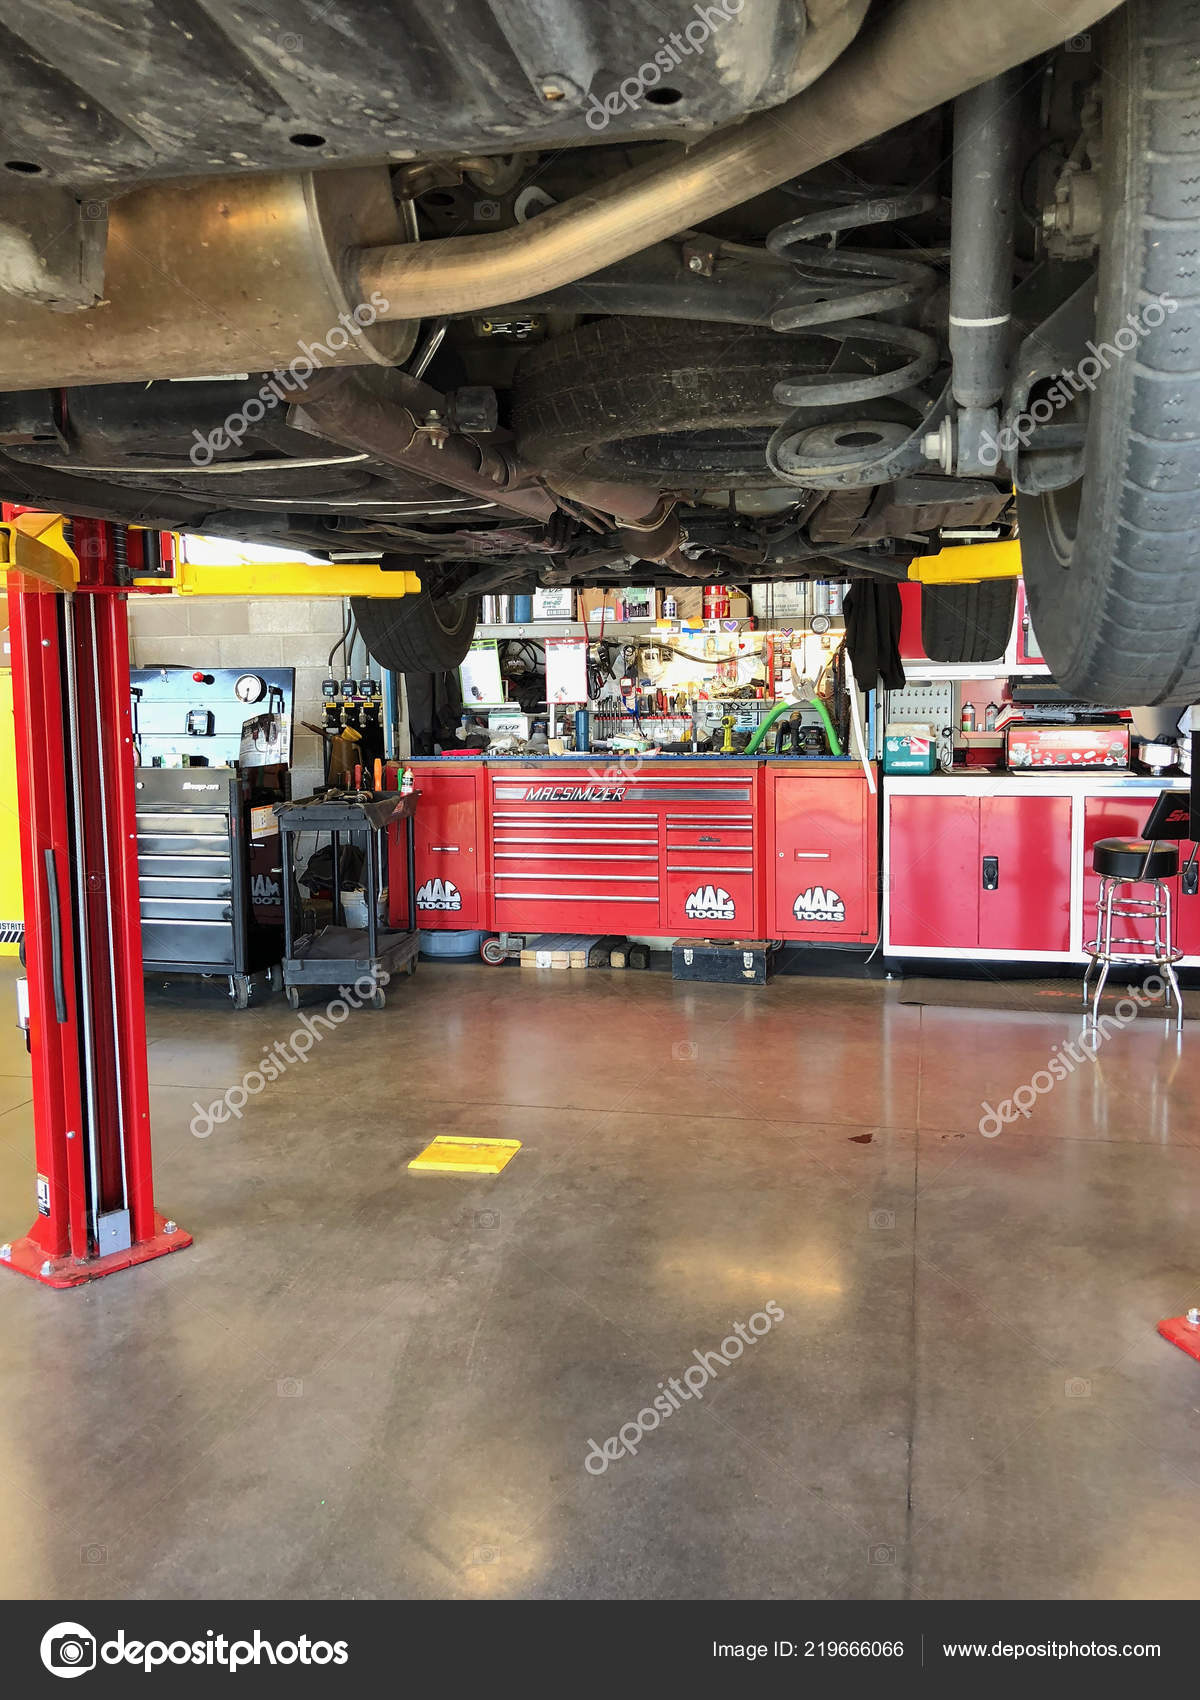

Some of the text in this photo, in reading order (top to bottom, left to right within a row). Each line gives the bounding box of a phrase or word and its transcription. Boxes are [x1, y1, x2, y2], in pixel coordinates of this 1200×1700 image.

[182, 782, 220, 792] Snap-on
[526, 787, 626, 801] MACSIMIZER
[416, 878, 461, 901] MAC
[685, 885, 735, 910] MAC
[793, 886, 844, 911] MAC
[416, 901, 461, 910] TOOLS
[685, 910, 735, 919] TOOLS
[795, 911, 844, 921] TOOLS
